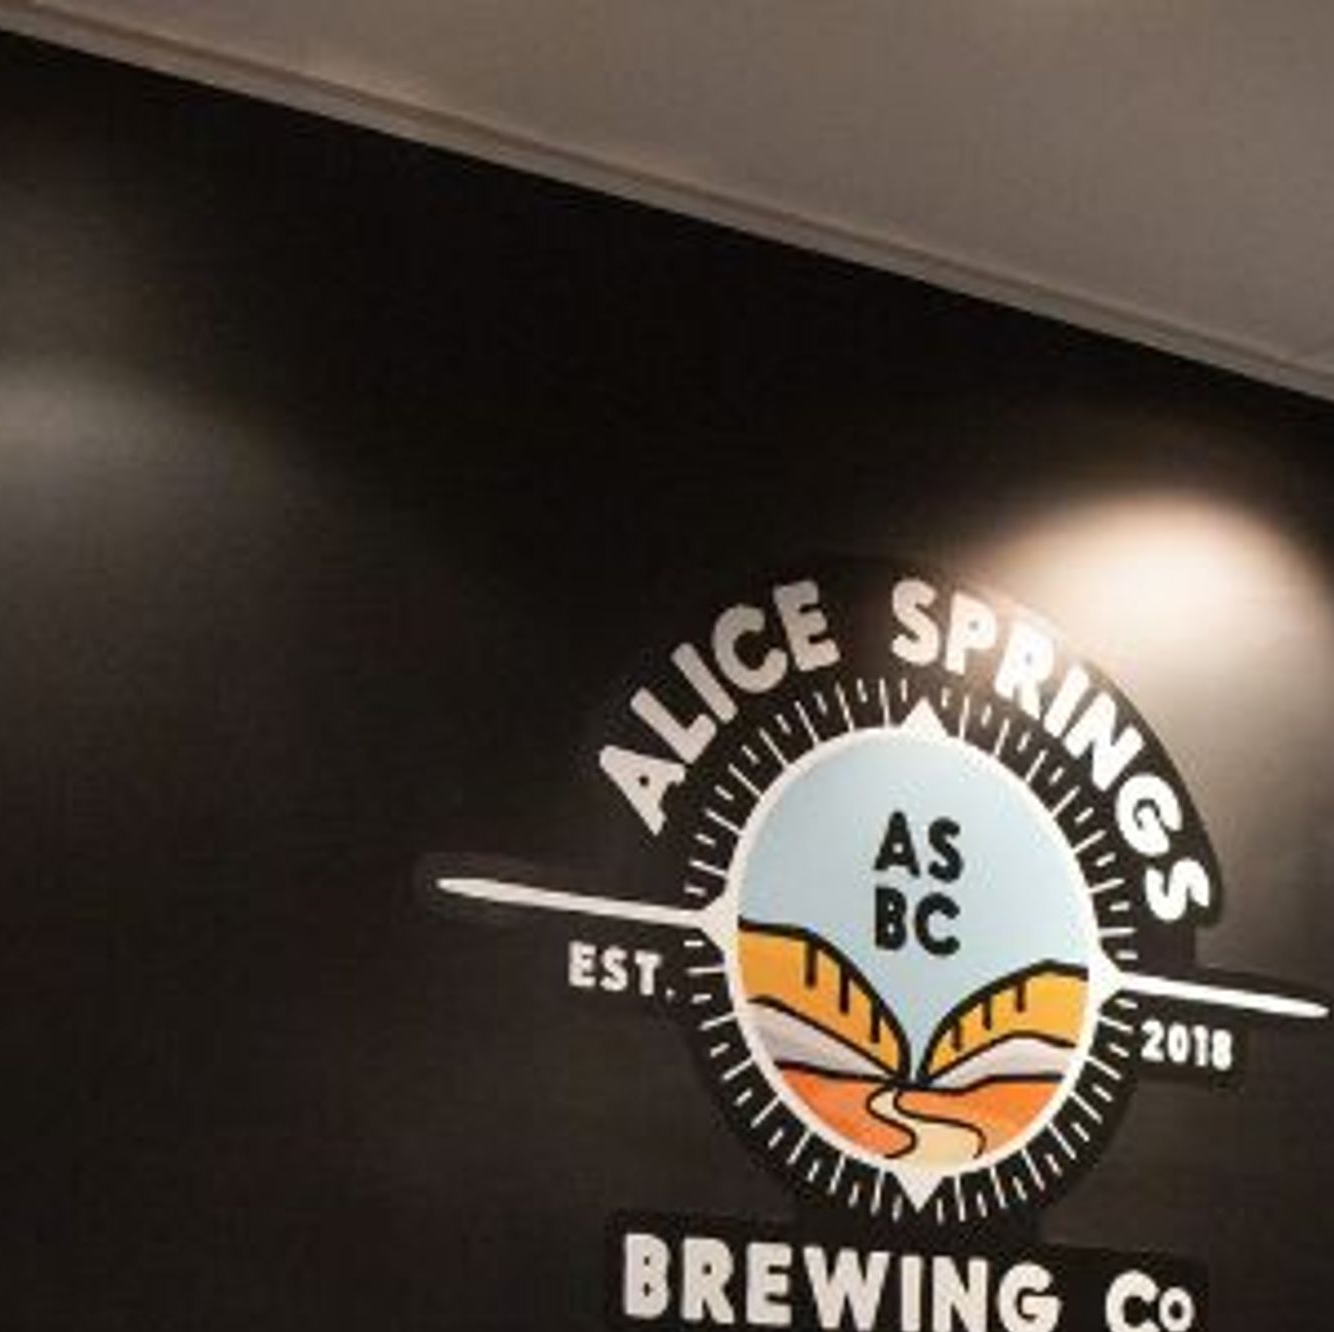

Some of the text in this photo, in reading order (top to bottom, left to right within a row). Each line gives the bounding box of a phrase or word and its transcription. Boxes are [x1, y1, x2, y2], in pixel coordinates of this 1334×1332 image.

[599, 577, 1211, 923] ALICE SPRINGS
[875, 811, 964, 882] AS
[874, 887, 960, 956] BC
[568, 941, 675, 998] EST.
[1141, 1021, 1233, 1069] 2018
